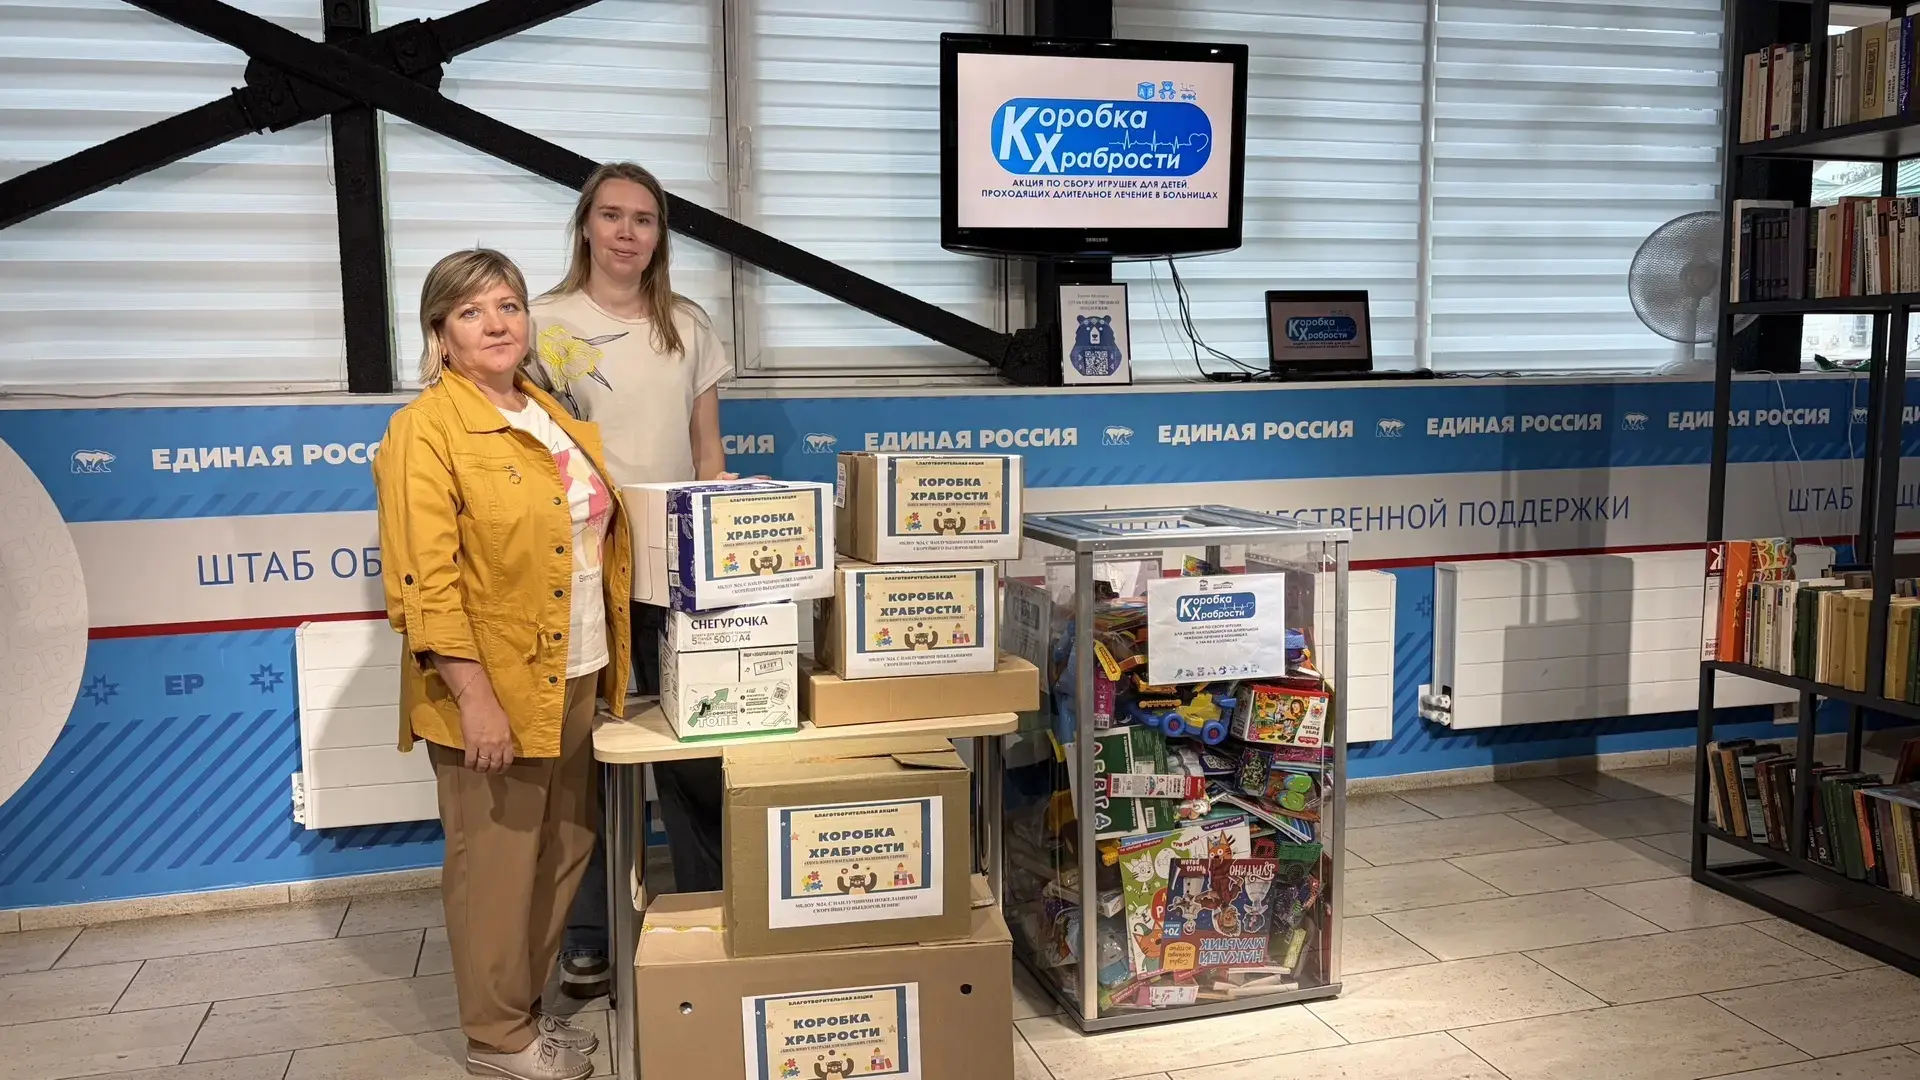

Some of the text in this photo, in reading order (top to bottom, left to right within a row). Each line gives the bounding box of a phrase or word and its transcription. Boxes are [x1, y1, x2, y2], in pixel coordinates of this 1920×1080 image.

[999, 102, 1148, 161] Коробка
[1029, 132, 1181, 174] Храбрости
[1012, 178, 1043, 188] АКЦИЯ
[1046, 179, 1061, 188] ПО
[1063, 179, 1094, 189] СБОРУ
[1097, 180, 1137, 189] ИГРУШЕК
[1139, 180, 1158, 190] ДЛЯ
[981, 189, 1218, 200] ПРОХОДЯЩИХ ДЛИТЕЛЬНОЕ ЛЕЧЕНИЕ В БОЛЬНИЦАХ
[1426, 414, 1602, 438] ЕДИНАЯ РОССИЯ
[1668, 408, 1830, 431] ЕДИАЯ РОССИЯ
[864, 427, 1078, 452] ЕДИНАЯ РОССИЯ
[1158, 420, 1354, 446] ЕДИНАЯ РОССИЯ
[721, 434, 775, 455] СИЯ
[152, 442, 381, 473] ЕДИНАЯ РОСС
[918, 478, 981, 487] КОРОБКА
[910, 492, 989, 501] ХРАБРОСТИ
[1788, 486, 1854, 512] ШТАБ
[733, 512, 795, 526] КОРОБКА
[1458, 495, 1630, 530] ПОДДЕРЖКИ
[726, 526, 802, 541] ХРАБРОСТИ
[196, 547, 383, 586] ШТАБ ОБ
[888, 591, 954, 602] КОРОБКА
[880, 605, 962, 616] ХРАБРОСТИ
[1179, 594, 1233, 618] Коробка
[1191, 606, 1245, 620] Храбрости
[691, 615, 768, 630] СНЕГУРОЧКА
[713, 635, 731, 644] 500
[165, 674, 204, 696] ЕР
[814, 809, 878, 818] БЛАГОТВОРИТЕЛЬНАЯ
[818, 827, 895, 842] КОРОБКА
[809, 842, 904, 859] ХРАБРОСТИ
[1163, 927, 1180, 936] 70+
[1199, 937, 1267, 951] МУЛЬТИК
[1198, 949, 1265, 966] НАКЛЕЙ
[788, 997, 852, 1006] БЛАГОТВОРИТЕЛЬНАЯ
[793, 1013, 870, 1030] КОРОБКА
[784, 1027, 880, 1047] ХРАБРОСТИ
